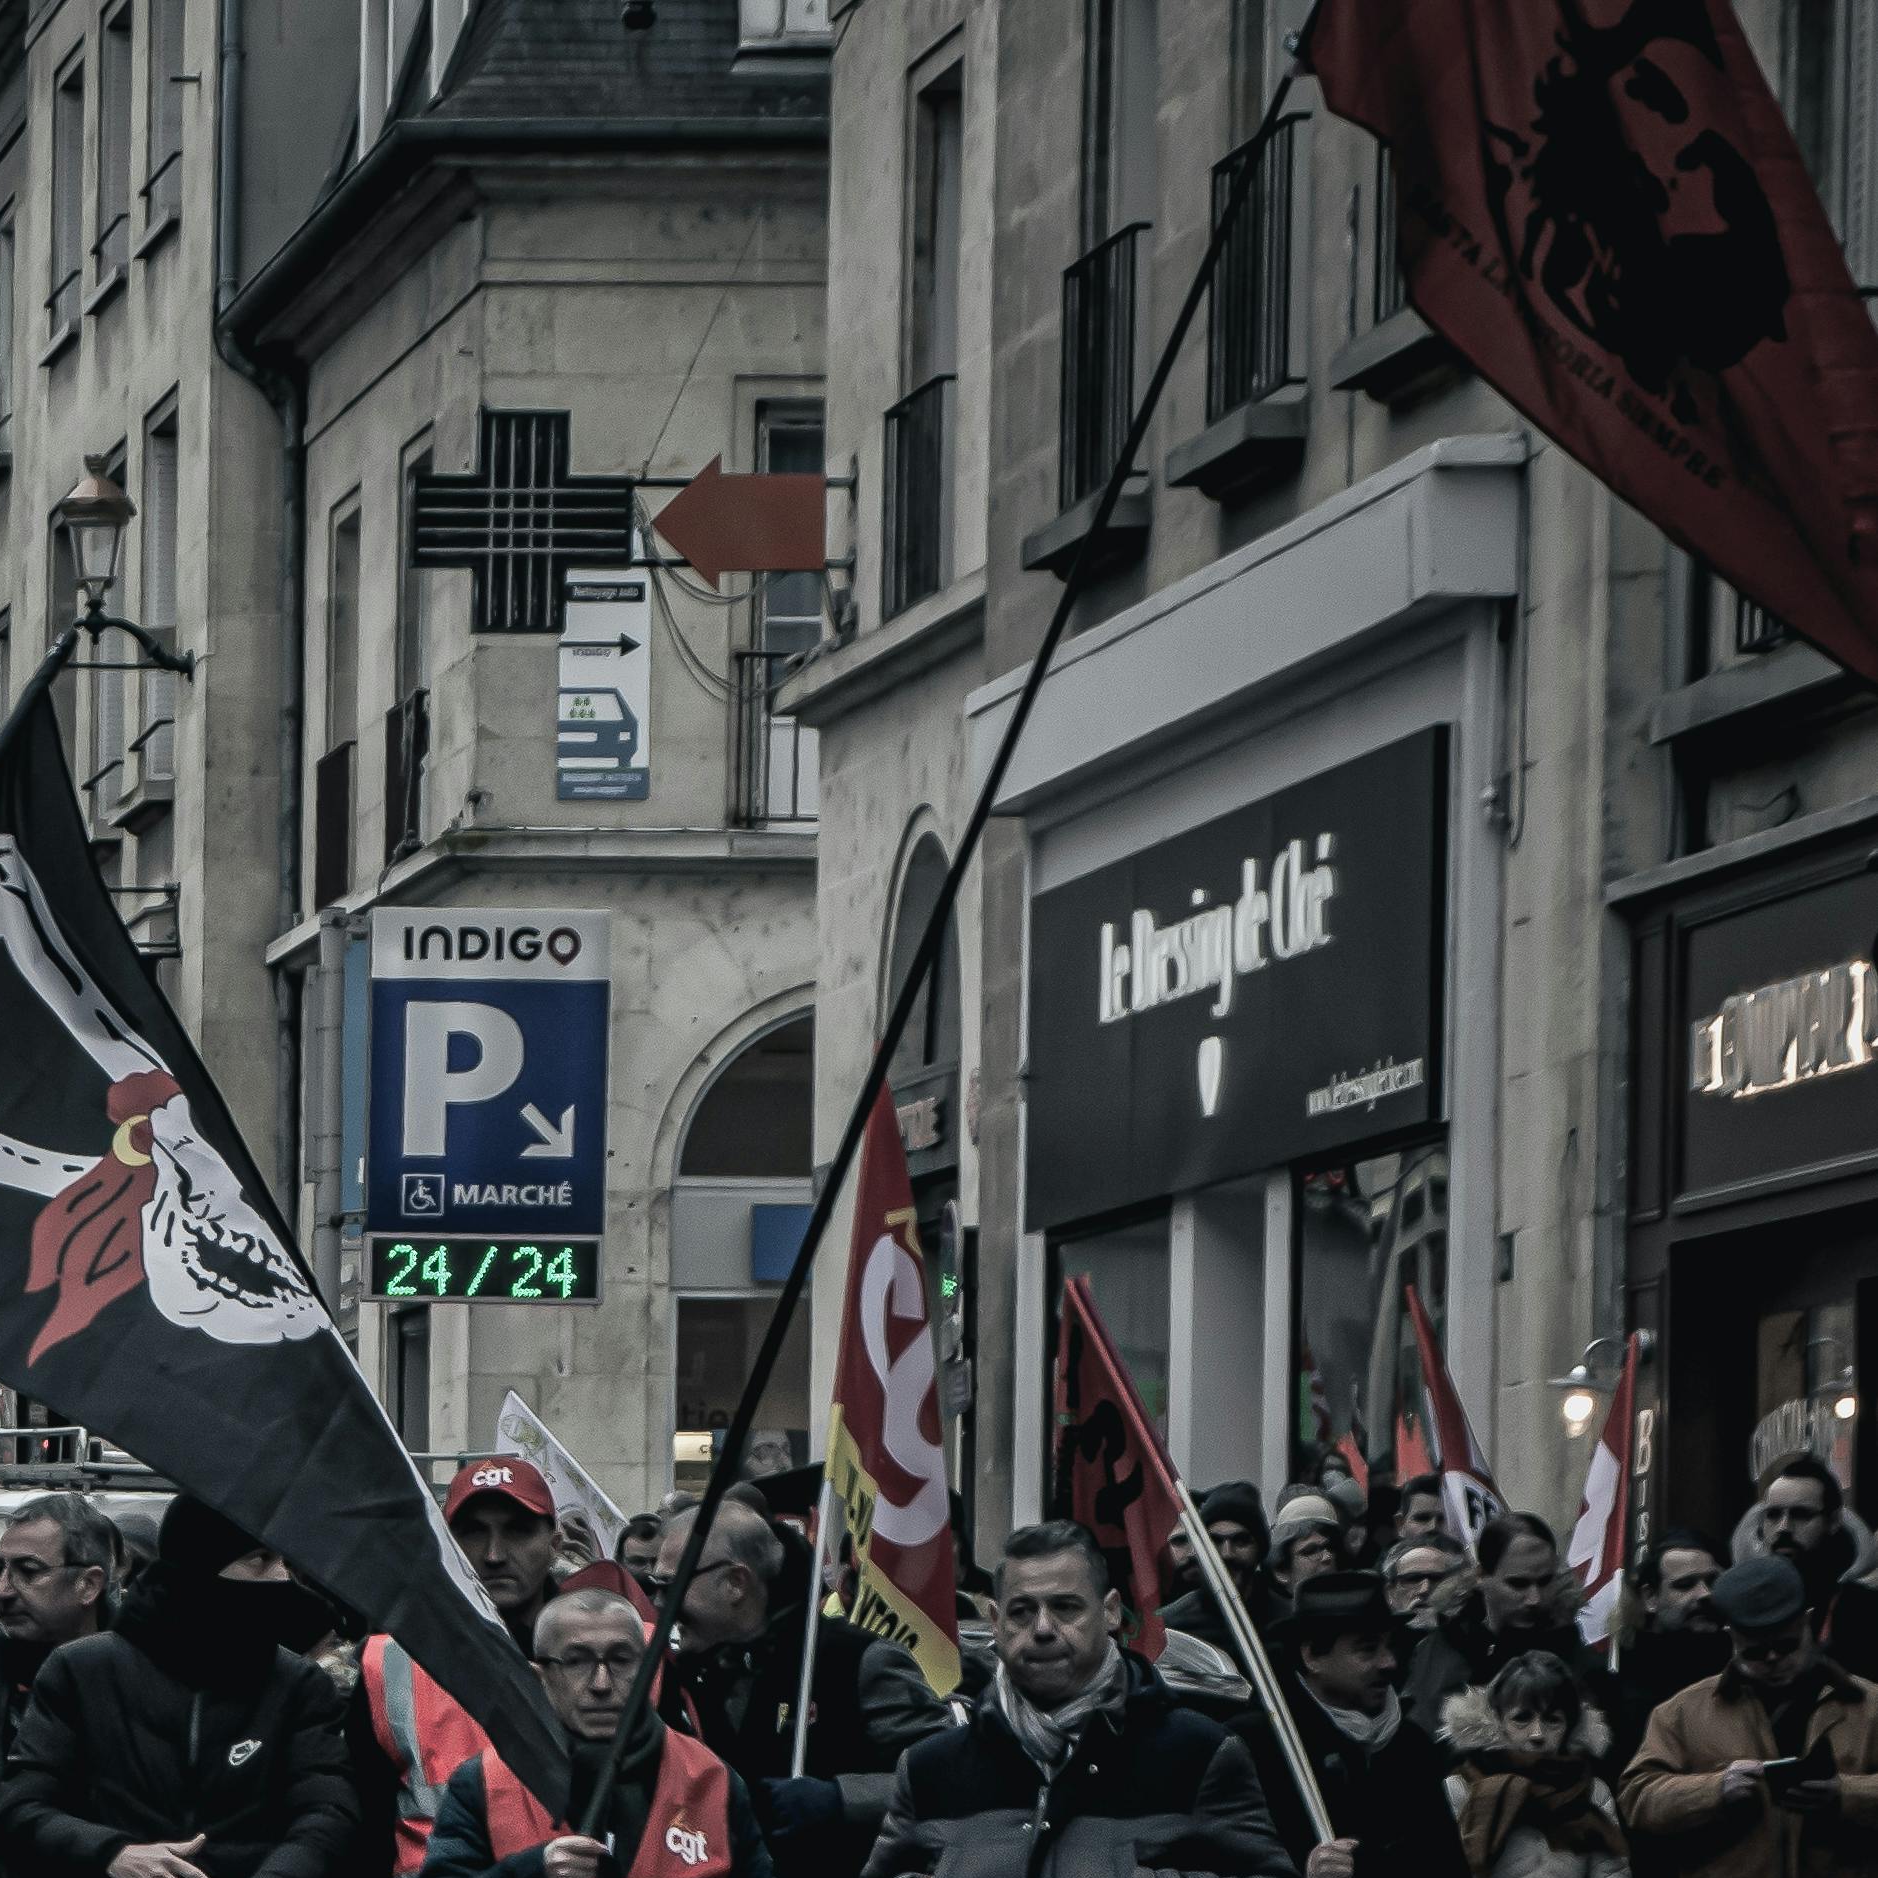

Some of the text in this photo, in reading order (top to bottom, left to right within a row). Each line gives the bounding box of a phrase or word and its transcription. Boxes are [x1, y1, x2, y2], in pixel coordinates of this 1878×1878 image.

[404, 926, 582, 966] INDIGO
[402, 1001, 525, 1158] P
[451, 1179, 574, 1207] MARCHÉ
[472, 1466, 514, 1487] cgt
[665, 1826, 709, 1867] cgt
